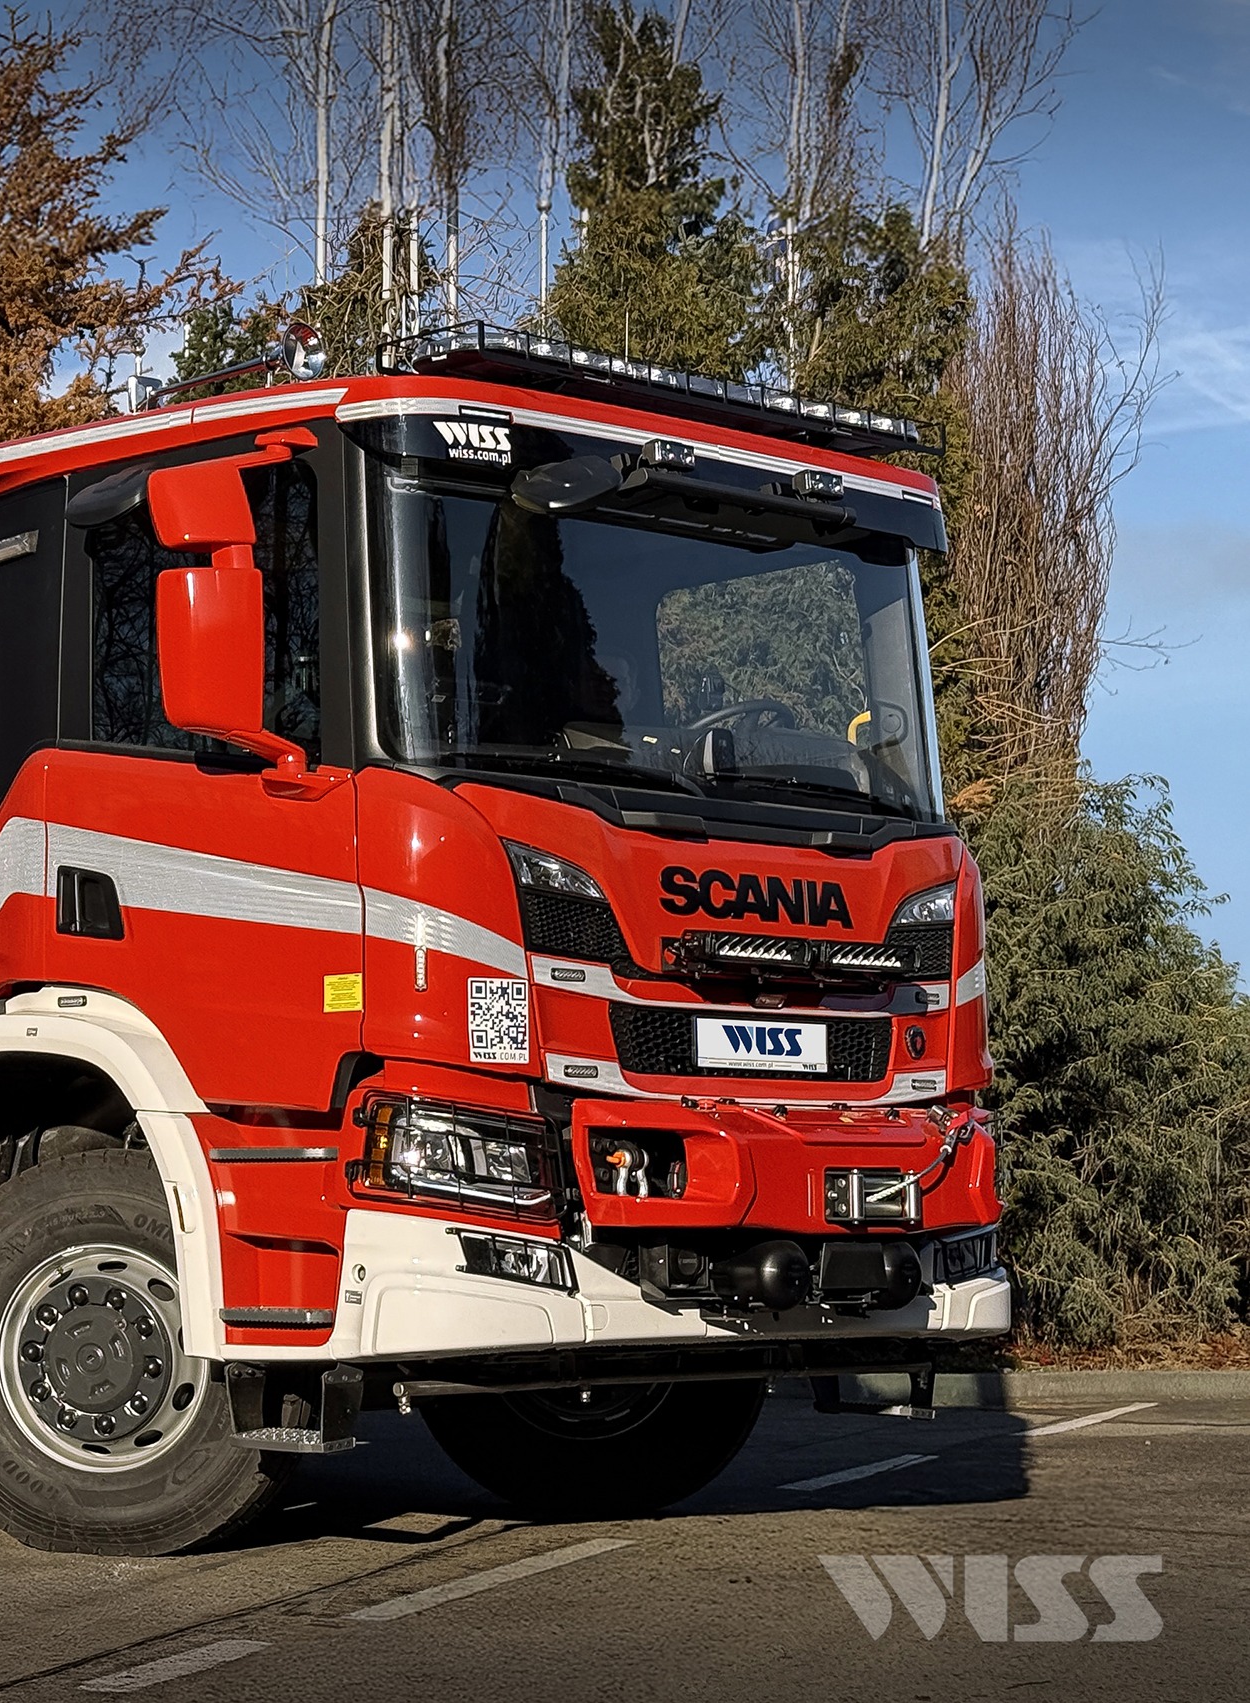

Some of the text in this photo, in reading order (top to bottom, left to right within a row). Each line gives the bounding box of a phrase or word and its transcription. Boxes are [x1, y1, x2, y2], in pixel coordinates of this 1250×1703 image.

[432, 421, 511, 451] WISS
[448, 446, 511, 466] wiss.com.pl
[659, 865, 854, 929] SCANIA
[721, 1025, 802, 1057] WISS
